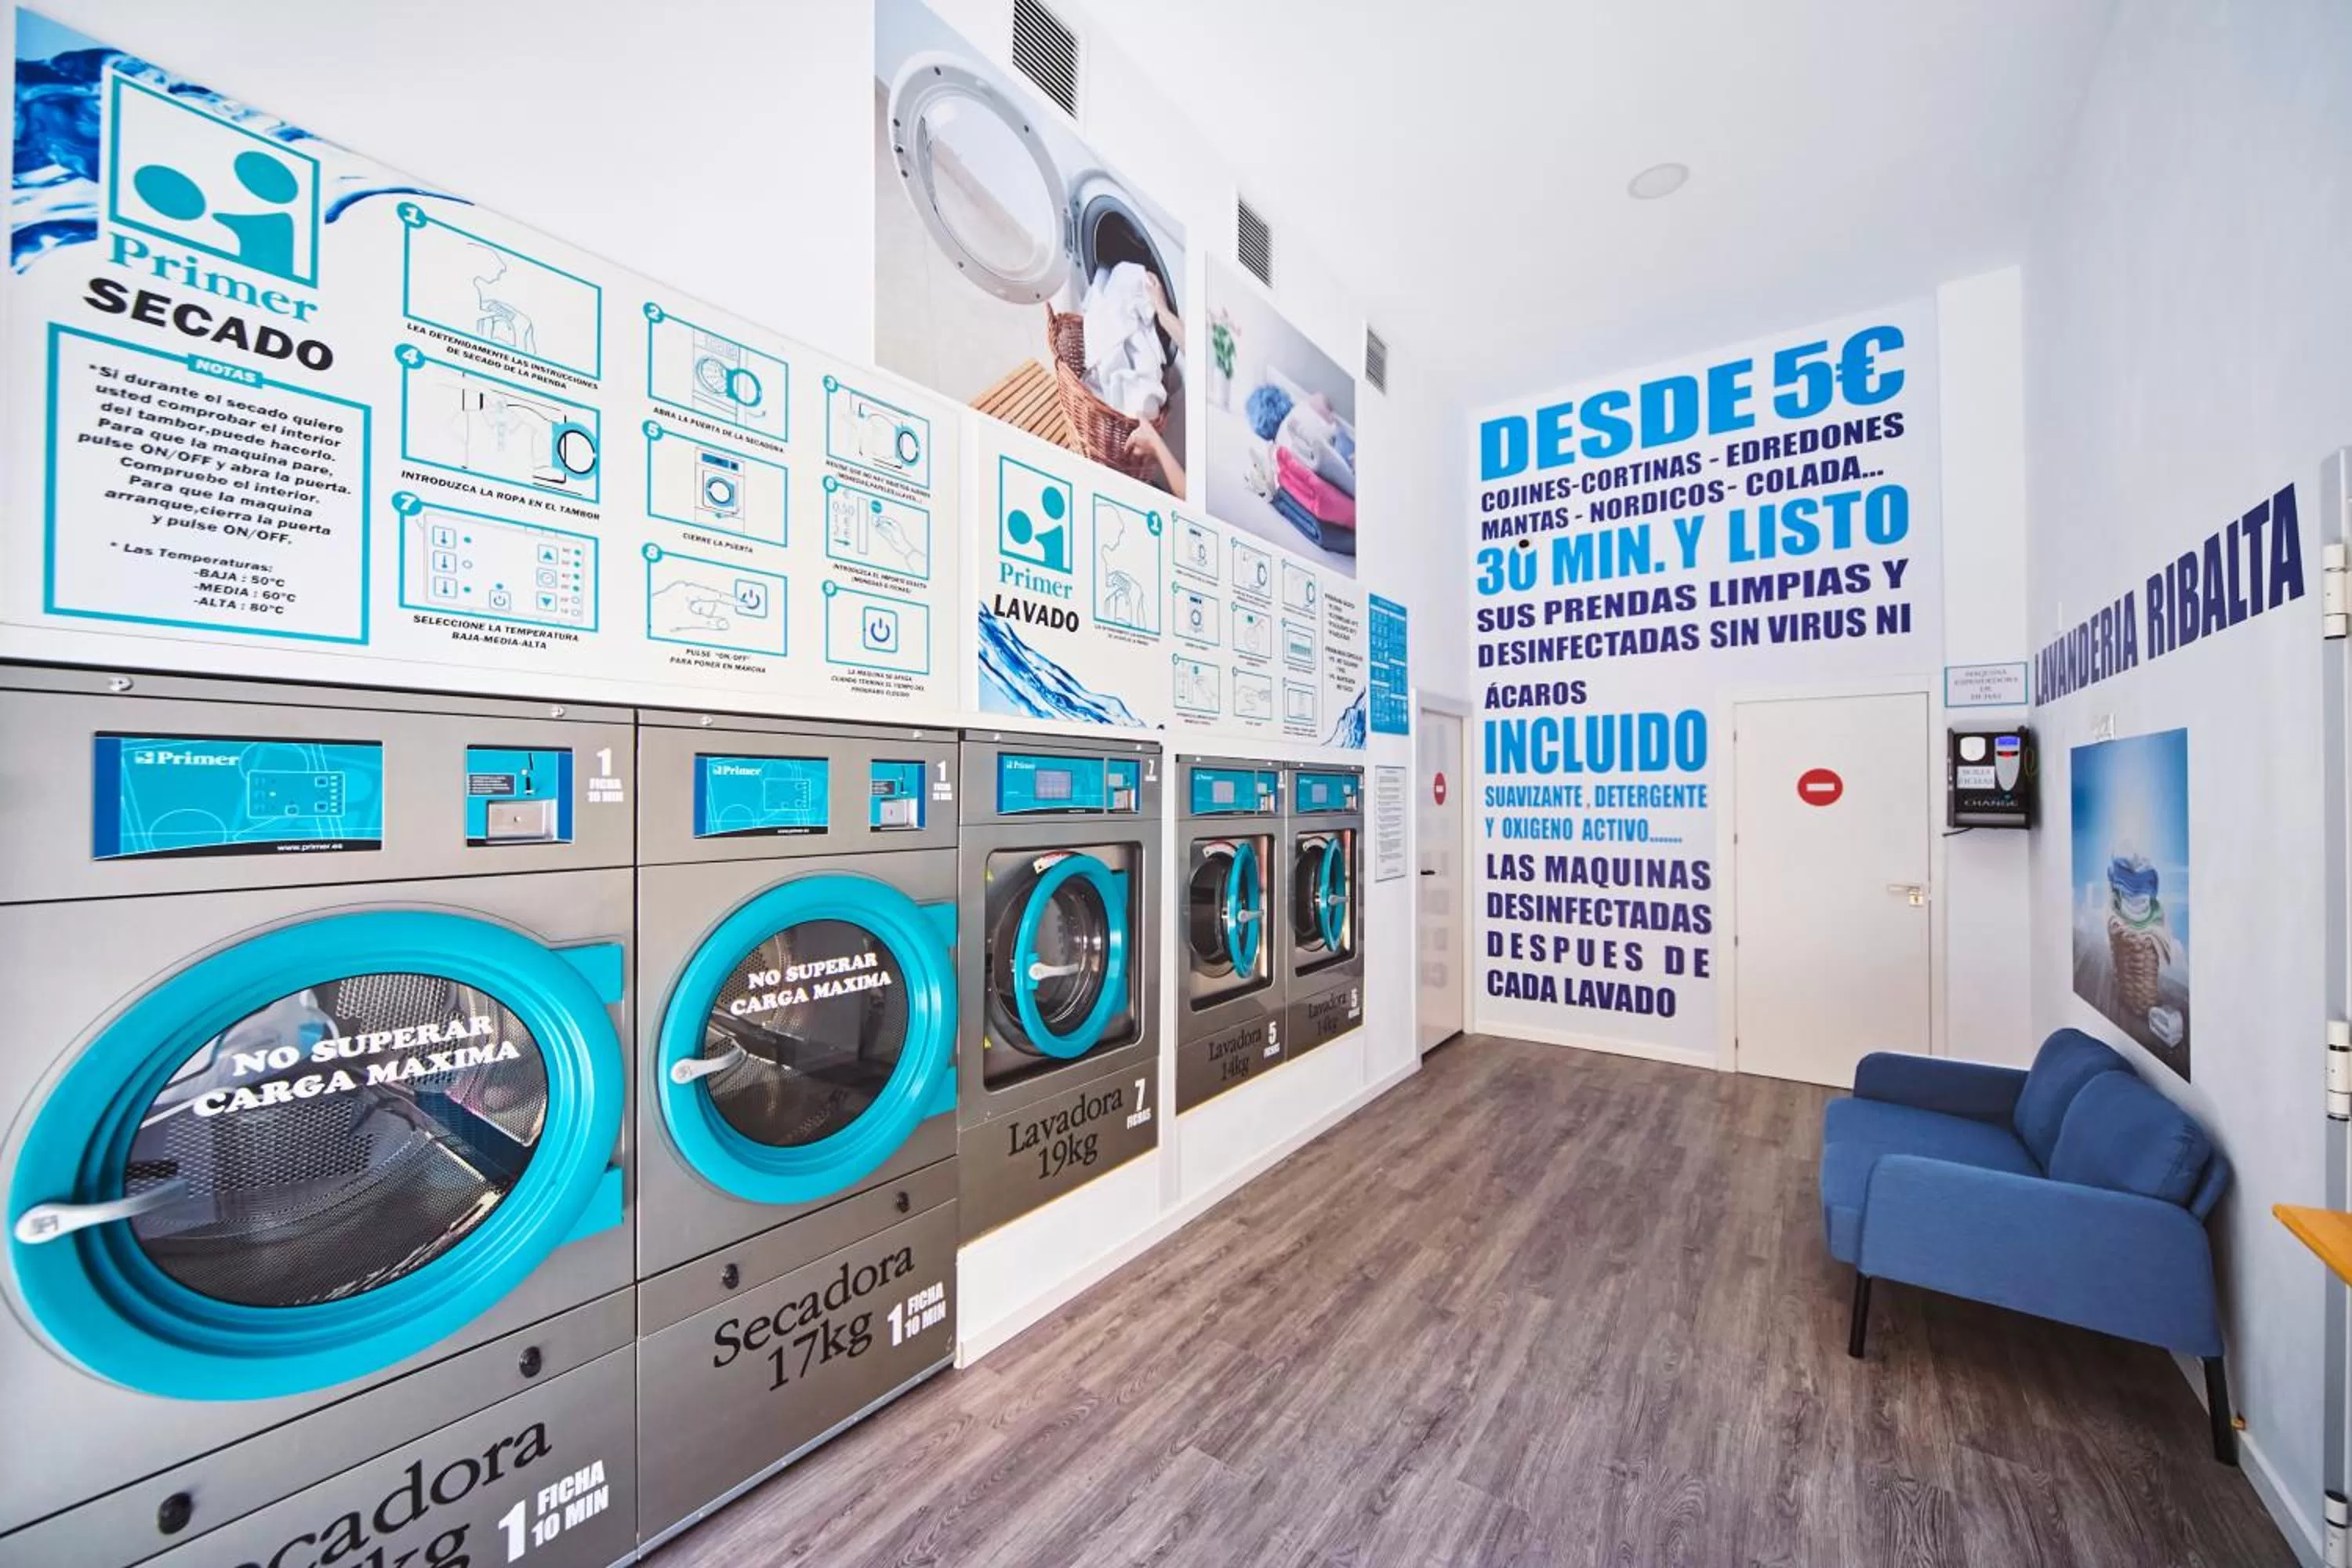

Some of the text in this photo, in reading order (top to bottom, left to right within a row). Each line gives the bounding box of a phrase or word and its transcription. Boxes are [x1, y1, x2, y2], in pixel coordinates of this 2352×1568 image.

[405, 207, 419, 224] 1
[107, 231, 318, 322] Primer
[82, 278, 333, 371] SECADO
[196, 359, 257, 383] NOTAS
[403, 349, 418, 364] 4
[406, 322, 598, 390] LEA DETENIDAMENTE LAS INSTRUCCIONES
[446, 346, 567, 389] DE SECADO DE LA PRENDA
[96, 385, 341, 448] usted comprobar el interior
[125, 374, 343, 433] durante el secado quiere
[1480, 325, 1905, 481] DESDE 5€
[98, 418, 288, 466] Para que la maquina
[100, 403, 132, 416] del
[270, 439, 336, 462] hacerlo.
[653, 406, 676, 419] ABRA
[690, 417, 720, 434] PUERTA
[722, 428, 731, 437] DE
[734, 432, 743, 441] LA
[745, 437, 784, 453] SECADORA
[78, 434, 351, 495] pulse ON/OFF y abra la puerta.
[1481, 412, 1904, 513] COJINES-CORTINAS EDREDONES
[129, 474, 313, 517] Para que la maquina
[234, 479, 250, 490] el
[255, 483, 320, 503] interior.
[400, 495, 414, 510] 7
[401, 470, 600, 520] INTRODUZCA LA ROPA EN EL TAMBOR
[1481, 507, 1568, 540] MANTAS
[1747, 455, 1884, 496] COLADA...
[151, 515, 292, 544] y pulse ON/OFF.
[257, 514, 273, 525] la
[278, 518, 331, 536] puerta
[1152, 514, 1160, 532] 1
[1476, 485, 1908, 596] 30 Y LISTO
[123, 543, 273, 573] Las Temperaturas:
[683, 532, 710, 545] CIERRE
[724, 541, 753, 554] PUERTA
[251, 575, 285, 588] 50°C
[263, 590, 296, 603] 60°C
[1000, 561, 1073, 599] Primer
[1477, 558, 1909, 633] SUS PRENDAS LIMPIAS Y
[2034, 482, 2305, 707] LAVANDERIA RIBALTA
[250, 603, 285, 615] 80°C
[413, 614, 579, 641] SELECCIONE LA TEMPERATURA
[993, 594, 1079, 632] LAVADO
[452, 631, 546, 649] BAJA-MEDIA-ALTA
[685, 648, 710, 659] PULSE
[1478, 604, 1911, 668] DESINFECTADAS SIN VIRUS NI
[670, 656, 766, 674] PARA PONER EN MARCHA
[1484, 680, 1587, 710] ÁCAROS
[157, 751, 238, 766] Primer
[596, 748, 612, 776] 1
[1483, 710, 1707, 775] INCLUIDO
[723, 766, 762, 776] Primer
[938, 760, 946, 781] 1
[1595, 784, 1708, 808] DETERGENTE
[1965, 798, 2018, 807] CHANGE
[1485, 818, 1494, 838] Y
[1502, 818, 1573, 840] OXIGENO
[1486, 853, 1711, 891] LAS MAQUINAS
[1487, 891, 1712, 935] DESINFECTADAS
[747, 953, 879, 990] NO SUPERAR
[1487, 931, 1709, 978] DESPUES DE
[730, 970, 892, 1015] CARGA MAXIMA
[1308, 992, 1346, 1018] Lavadora
[1350, 988, 1358, 1008] 5
[1487, 970, 1675, 1018] CADA LAVADO
[233, 1014, 494, 1076] NO SUPERAR
[1208, 1021, 1277, 1061] Lavadora 5
[193, 1040, 520, 1117] CARGA MAXIMA
[1221, 1054, 1250, 1081] 14kg
[1008, 1087, 1123, 1156] Lavadora
[1038, 1131, 1098, 1180] 19kg
[713, 1246, 915, 1368] Secadora
[907, 1281, 945, 1317] FICHA
[905, 1301, 946, 1338] 10 MIN
[768, 1302, 902, 1392] 17kg 1
[498, 1499, 527, 1563] 1
[536, 1459, 605, 1516] FICHA
[532, 1485, 609, 1548] 10 MIN
